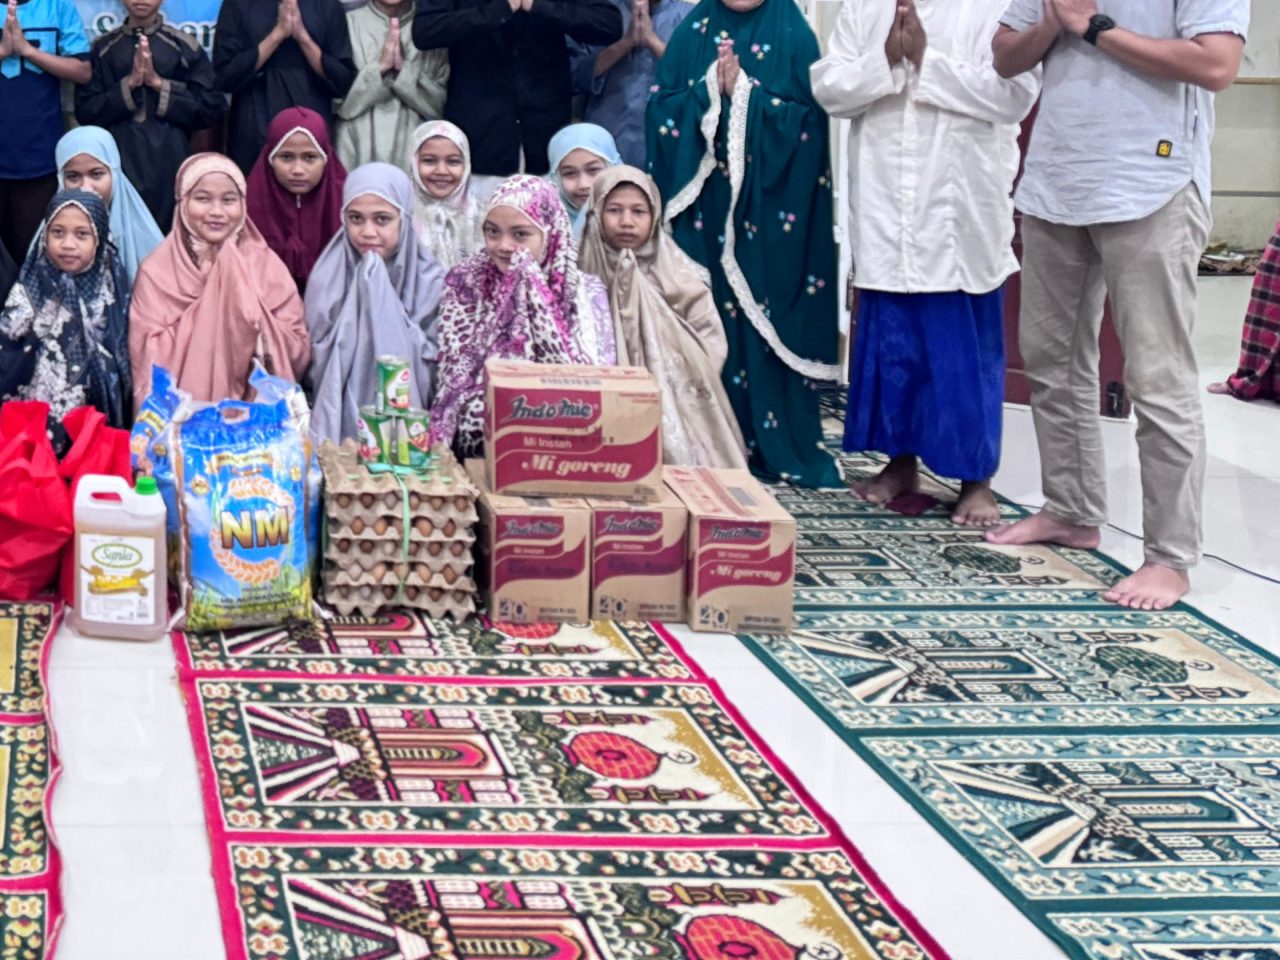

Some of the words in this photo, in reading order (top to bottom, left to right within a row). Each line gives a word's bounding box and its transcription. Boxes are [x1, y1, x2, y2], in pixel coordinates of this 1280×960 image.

[521, 454, 557, 472] Mi
[556, 461, 633, 479] goreng
[220, 506, 290, 549] NM
